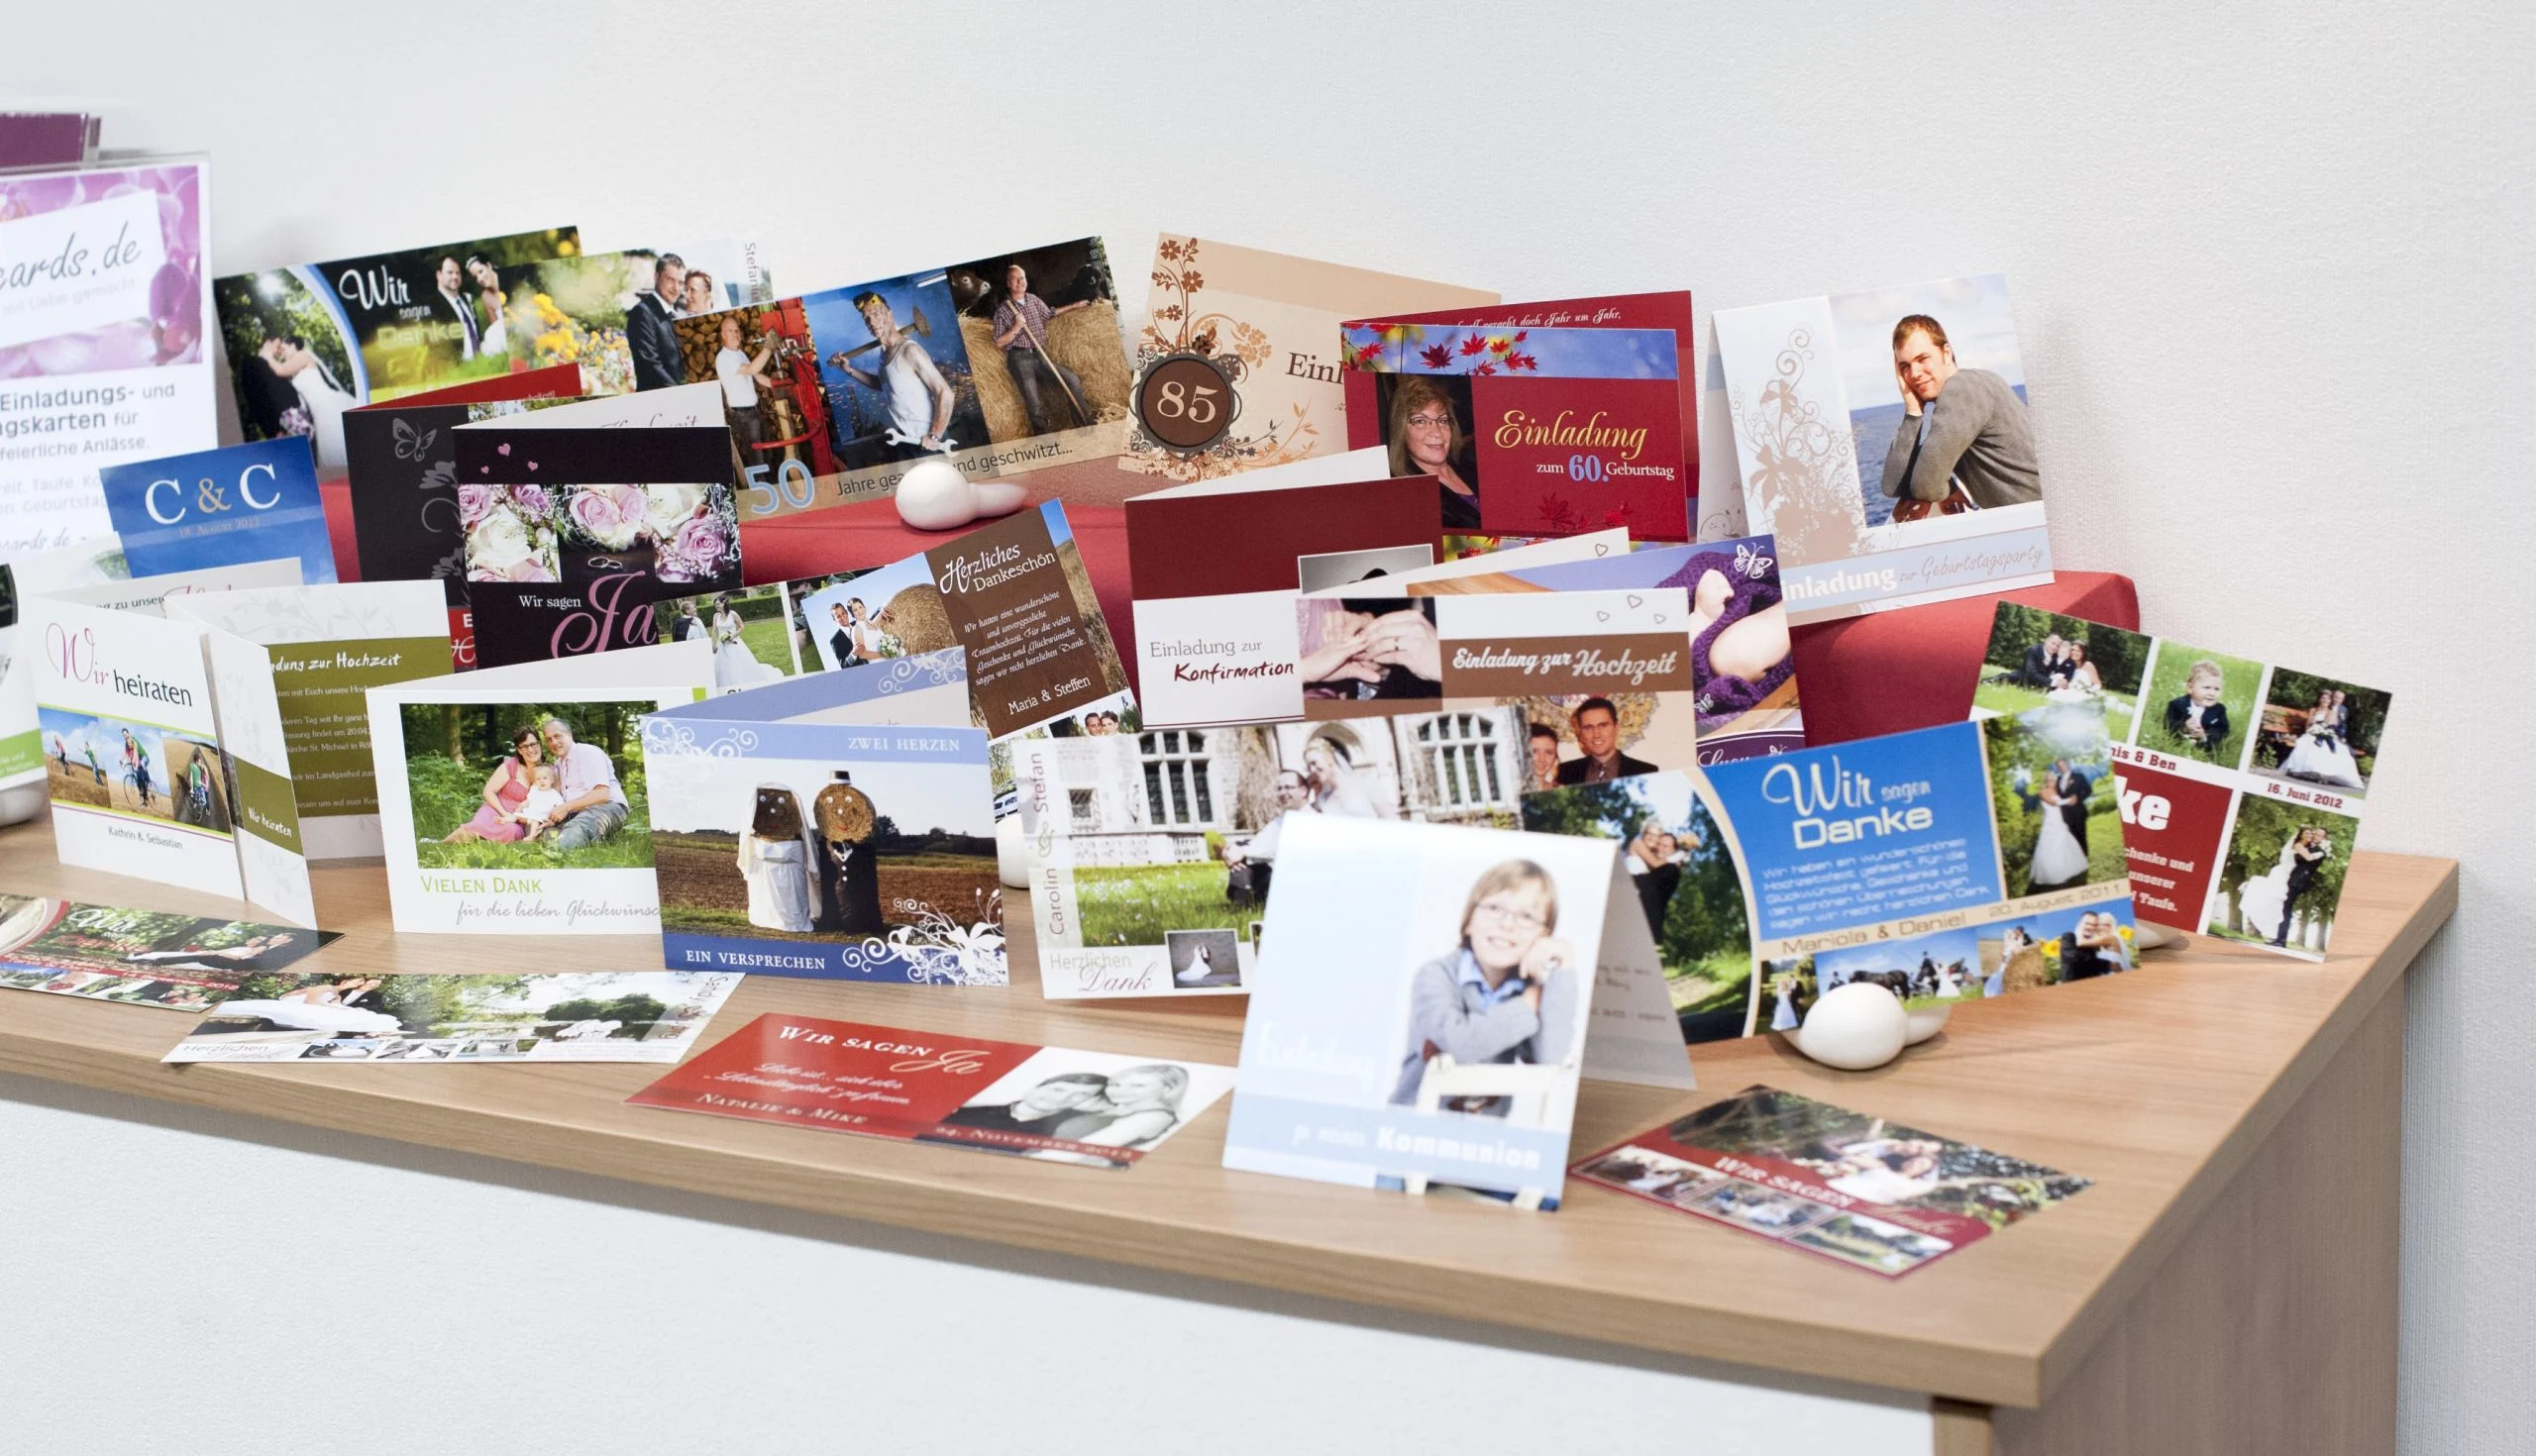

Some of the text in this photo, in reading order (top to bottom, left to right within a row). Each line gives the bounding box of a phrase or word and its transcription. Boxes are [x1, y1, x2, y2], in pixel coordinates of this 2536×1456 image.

[339, 263, 411, 310] Wir
[1520, 312, 1589, 328] doch Jahr um
[1, 383, 175, 411] Einladungs- und
[1156, 380, 1218, 424] 85
[114, 411, 140, 426] für
[1494, 409, 1647, 461] Einladung
[837, 476, 876, 496] Jahre
[980, 442, 1074, 473] geschwitzt...
[1536, 454, 1675, 482] zum 60. Geburtstag
[146, 463, 281, 525] C & C
[744, 459, 815, 515] 50
[939, 544, 1021, 594] Herzliches
[972, 552, 1057, 592] Dankeschön
[1899, 571, 1918, 582] zur
[1921, 544, 2045, 584] Geburtstagsparty
[115, 599, 129, 610] zu
[518, 594, 582, 611] Wir sagen
[551, 570, 658, 661] Ja
[964, 590, 1061, 634] Wir hatten eine wunderschöne
[986, 628, 1001, 640] und
[1023, 627, 1040, 639] Für
[1040, 623, 1052, 634] die
[1052, 615, 1072, 628] vielen
[308, 659, 333, 671] zur
[336, 651, 403, 669] Hochzeit
[976, 651, 1011, 675] Geschenke
[1012, 646, 1027, 658] und
[1149, 637, 1263, 659] Einladung zur
[46, 622, 193, 707] Wir heiraten
[975, 673, 996, 687] sagen
[997, 666, 1008, 677] wir
[1173, 660, 1296, 685] Konfirmation
[1452, 645, 1679, 686] Einladung zur Hochzeit
[1007, 676, 1092, 715] Maria & Steffen
[847, 736, 961, 753] ZWEI HERZEN
[2134, 751, 2177, 772] & Ben
[1029, 752, 1050, 814] Stefan
[1760, 755, 1875, 818] Wir
[1880, 780, 1932, 804] sagen
[2286, 786, 2311, 801] Juni
[2313, 793, 2344, 809] 2012
[107, 825, 183, 850] Kathrin & Sebastian
[248, 807, 293, 840] Wir heiraten
[1793, 805, 1934, 851] Danke
[2168, 858, 2195, 873] und
[455, 899, 483, 926] für
[485, 899, 512, 918] die
[514, 899, 562, 918] lieben
[1043, 867, 1066, 937] Carolin
[1781, 928, 1868, 955] Mariola
[1876, 923, 1890, 940] &
[1898, 911, 1967, 937] Daniel
[2020, 893, 2075, 914] August
[2079, 883, 2122, 904] 2011
[686, 949, 826, 971] EIN VERSPRECHEN
[1049, 951, 1132, 971] Herzlichen
[1077, 961, 1158, 992] Dank
[1375, 1125, 1541, 1170] Kommunion
